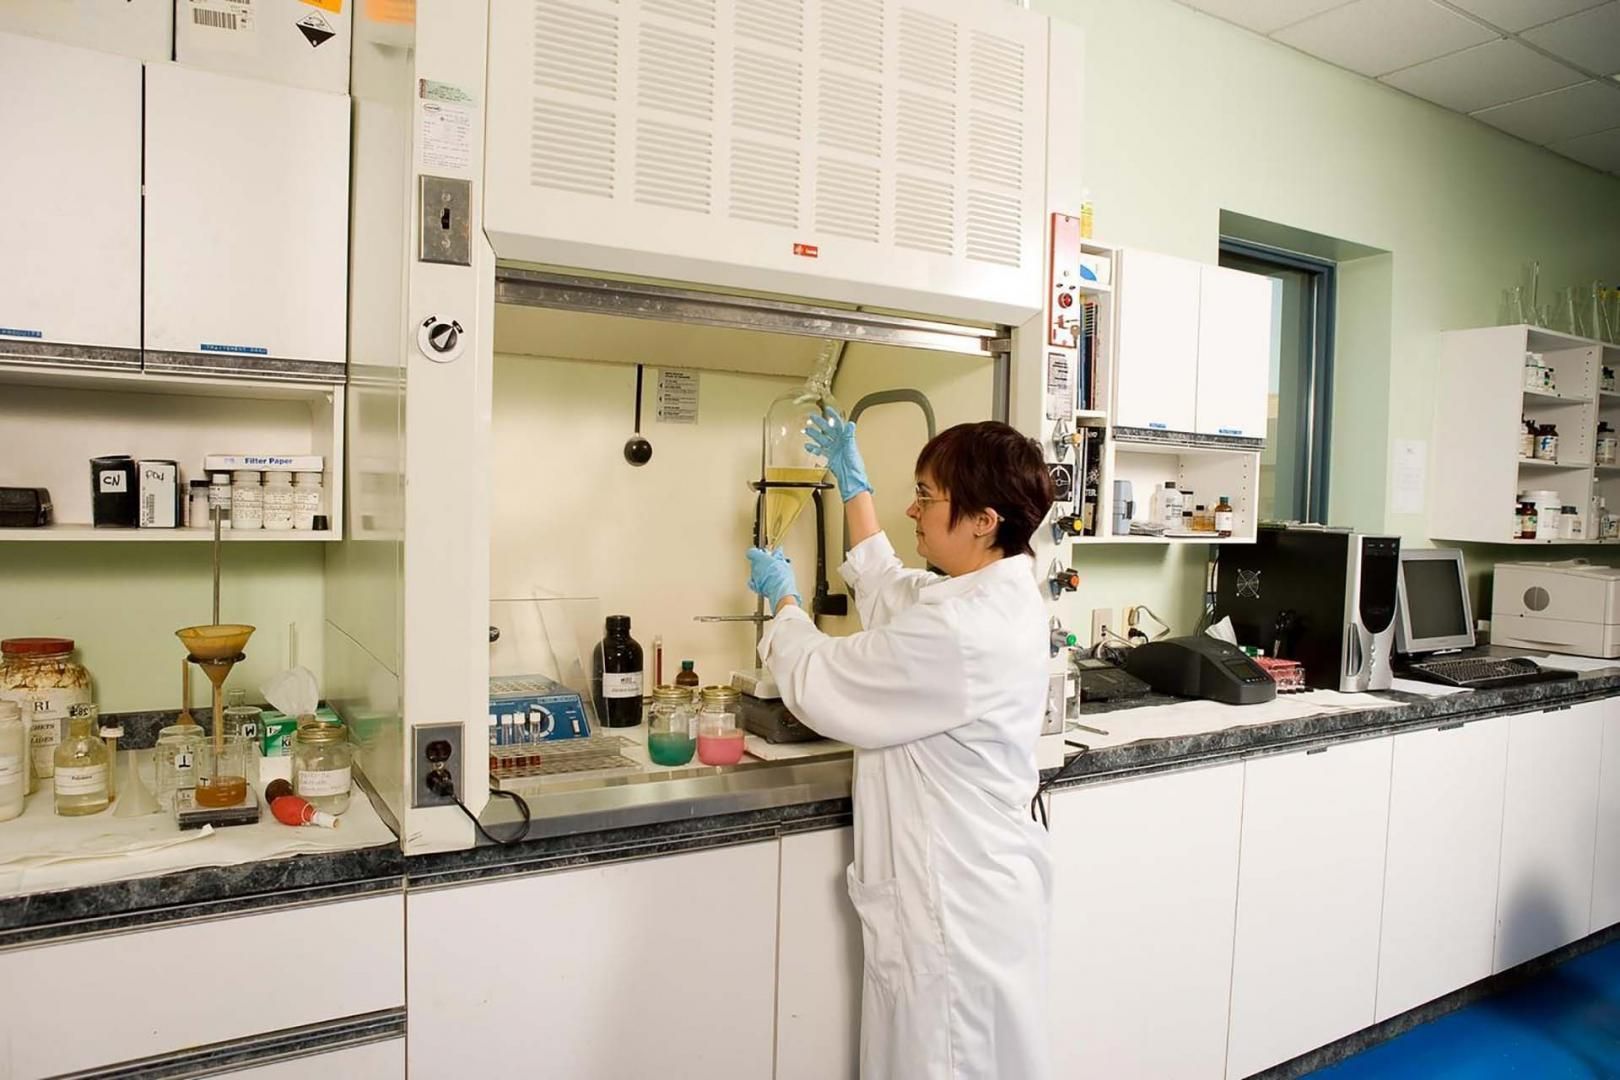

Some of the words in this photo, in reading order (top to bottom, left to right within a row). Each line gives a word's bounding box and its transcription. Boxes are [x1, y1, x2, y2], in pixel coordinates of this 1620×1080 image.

[244, 457, 268, 465] Filter
[268, 457, 293, 466] Paper
[103, 475, 120, 486] CN
